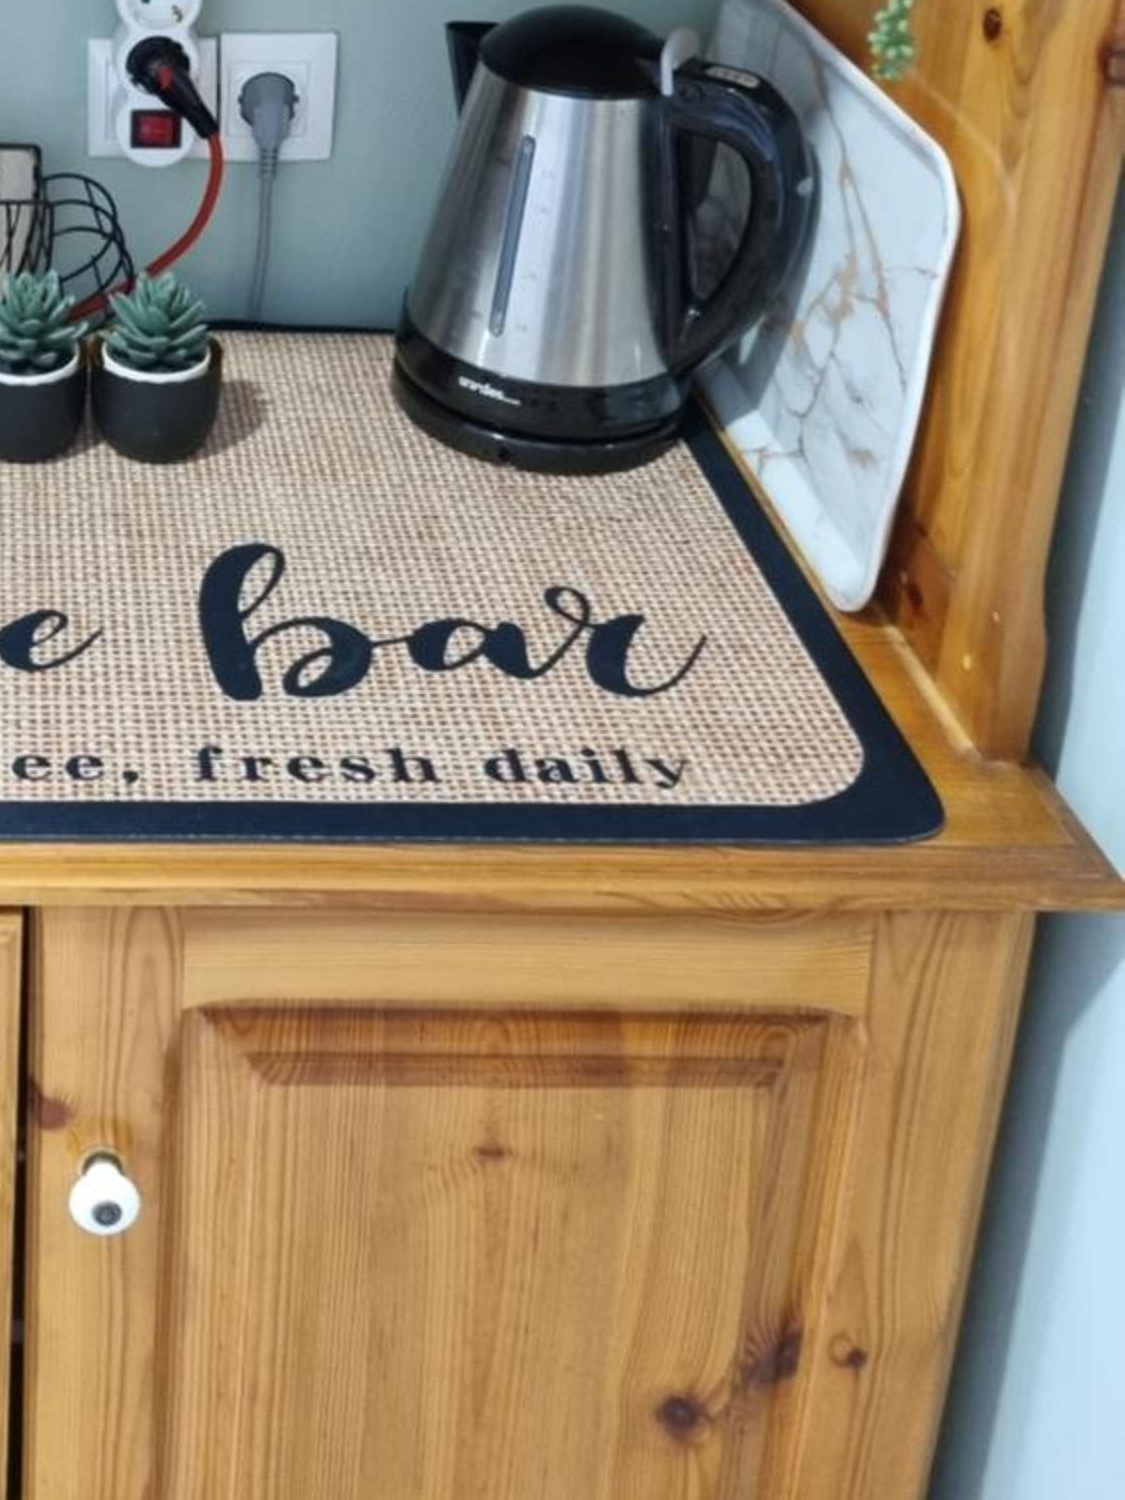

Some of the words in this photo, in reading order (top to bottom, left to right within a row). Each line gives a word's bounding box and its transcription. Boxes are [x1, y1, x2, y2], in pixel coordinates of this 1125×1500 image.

[198, 543, 707, 700] bar
[196, 745, 439, 784] fresh
[484, 746, 689, 790] daily
